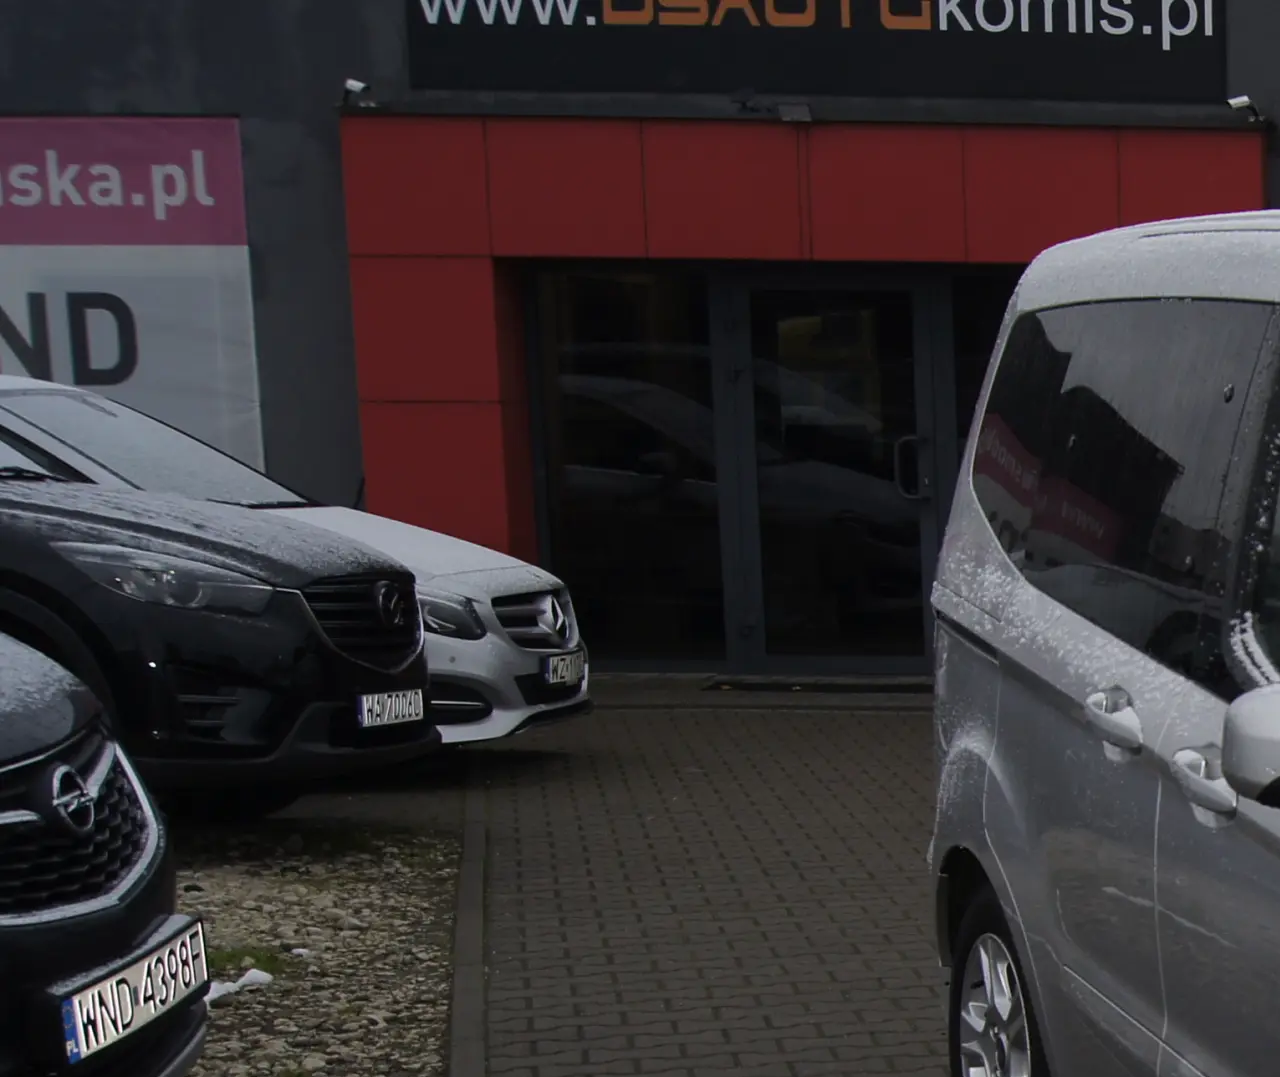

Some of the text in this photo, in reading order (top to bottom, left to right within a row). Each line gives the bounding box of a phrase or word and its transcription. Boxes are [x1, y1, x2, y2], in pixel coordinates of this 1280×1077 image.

[0, 149, 216, 220] ska.pl
[77, 929, 201, 1053] WND 4398F
[66, 1039, 79, 1057] PL
